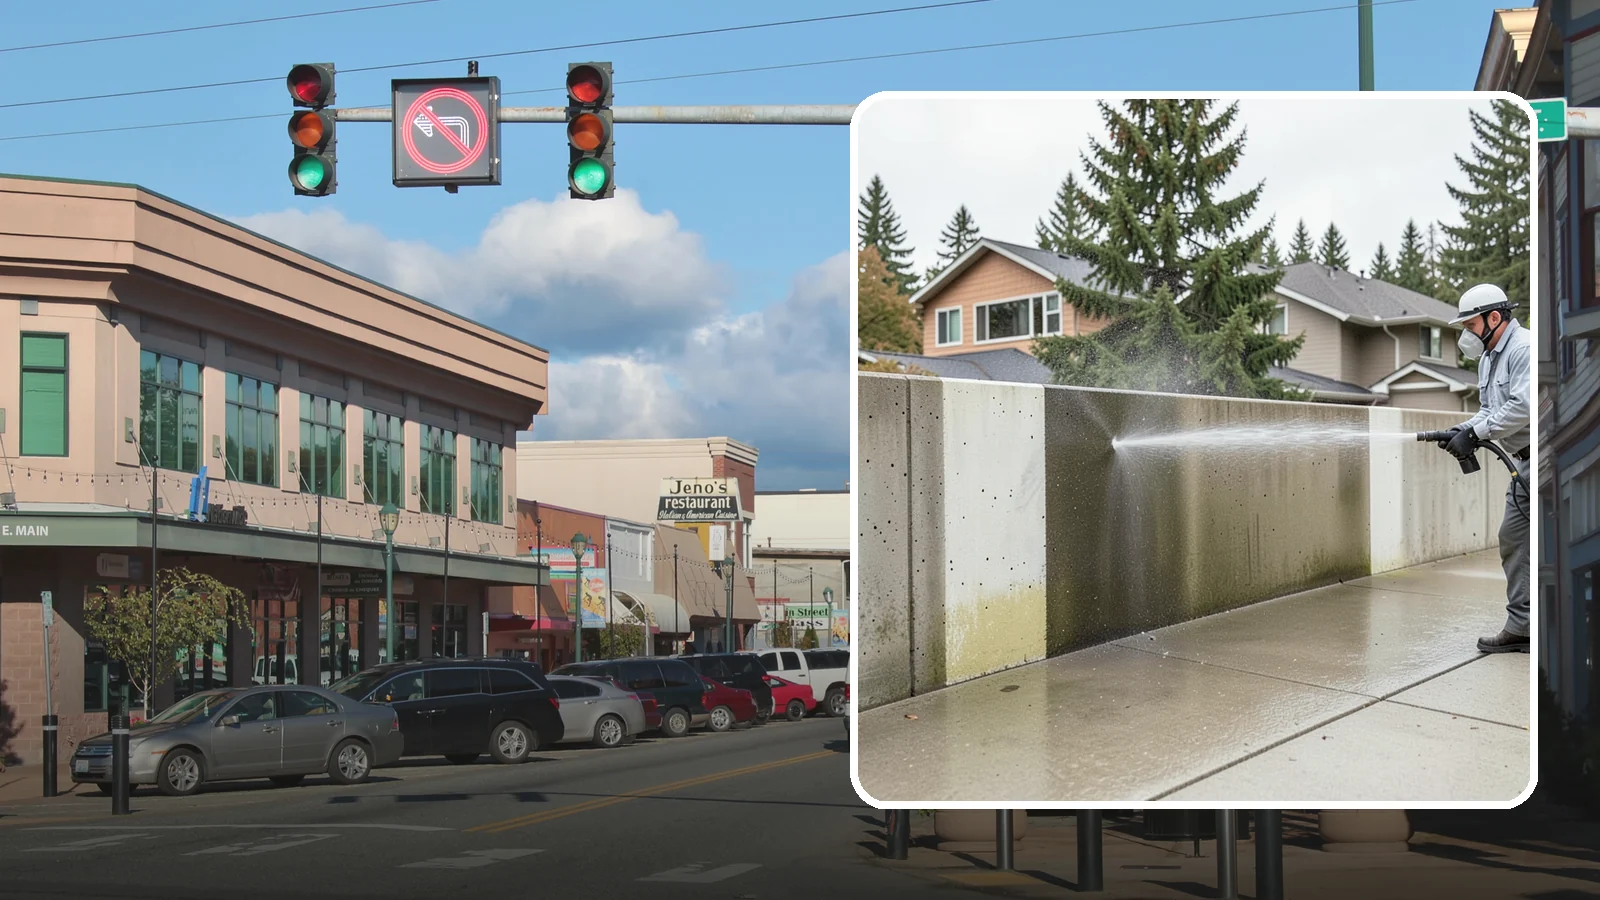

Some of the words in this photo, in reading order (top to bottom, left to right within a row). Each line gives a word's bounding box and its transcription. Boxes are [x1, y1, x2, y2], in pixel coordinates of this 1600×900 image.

[670, 480, 727, 494] Jeno's
[665, 496, 730, 508] restaurant
[686, 510, 714, 519] American
[715, 510, 737, 518] Cuisine
[2, 526, 12, 536] E.
[16, 526, 48, 536] MAIN
[798, 608, 828, 616] Street
